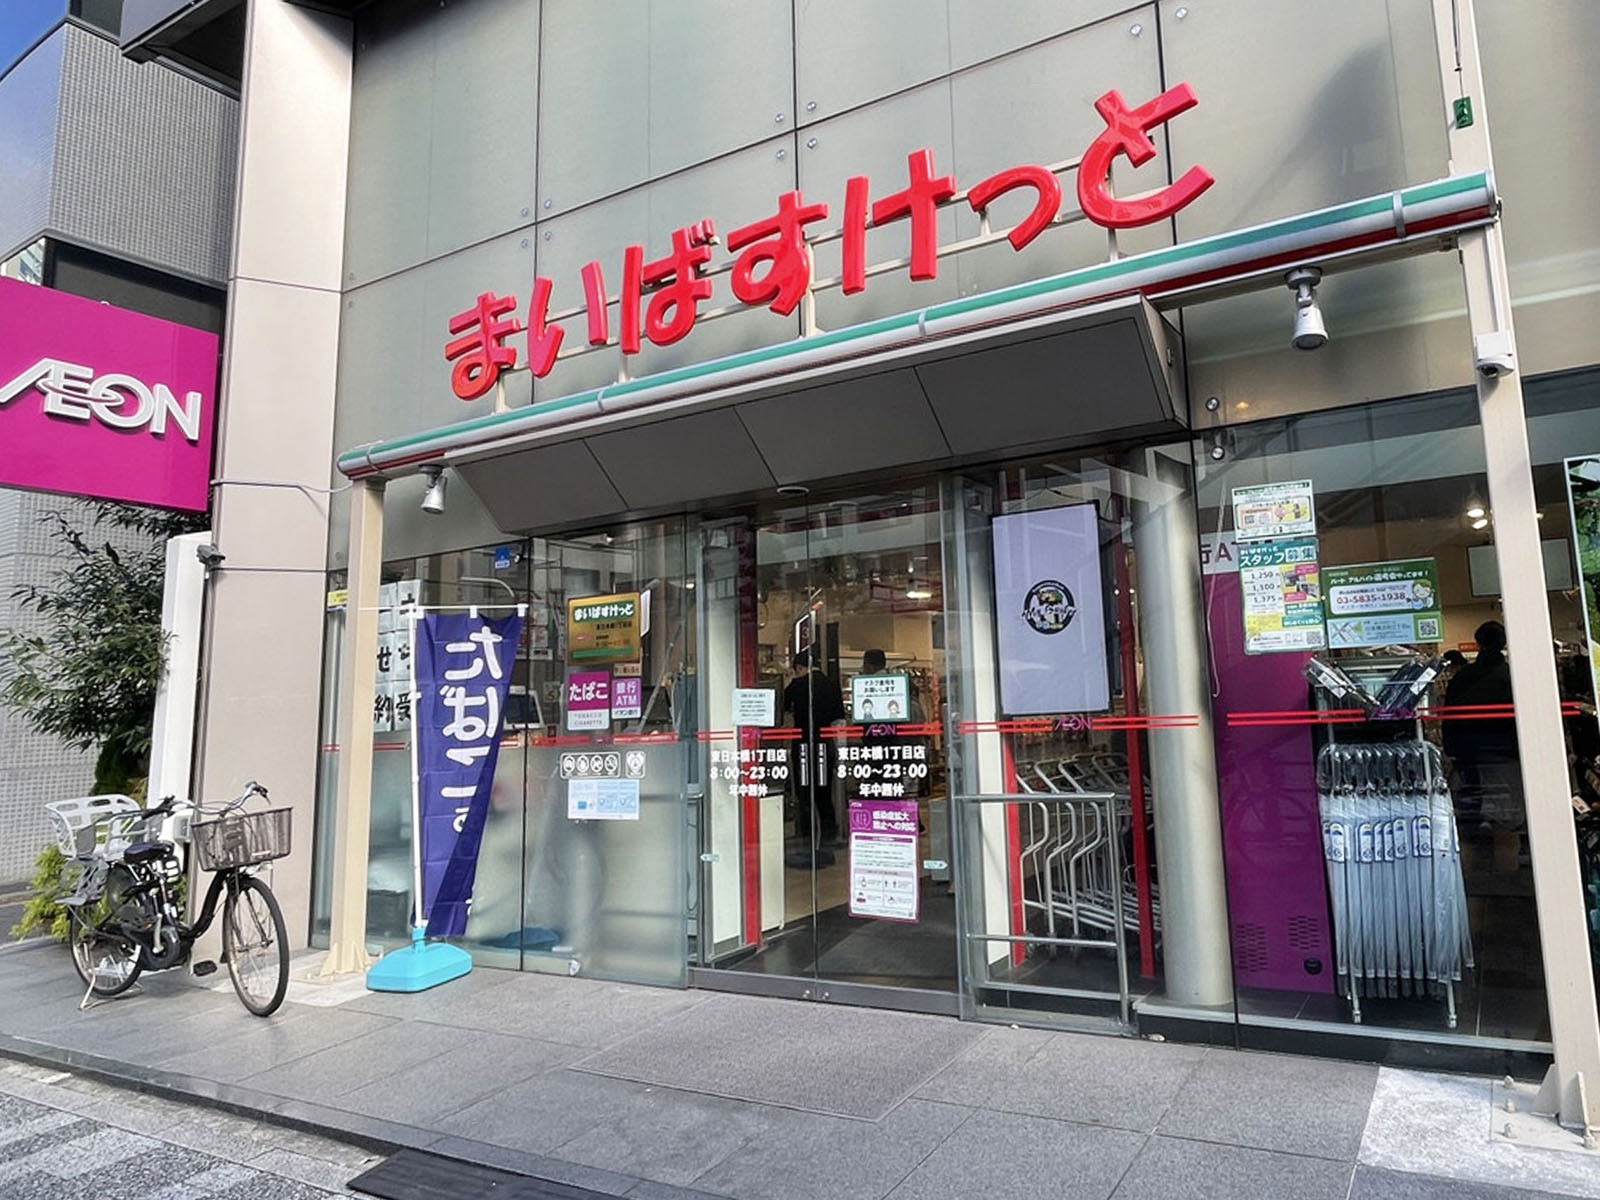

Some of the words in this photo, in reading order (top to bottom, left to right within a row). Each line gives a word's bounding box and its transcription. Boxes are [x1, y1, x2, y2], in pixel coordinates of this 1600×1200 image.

[445, 81, 1215, 400] まいばすけっと
[569, 681, 608, 701] たばこ
[616, 681, 636, 695] 銀行
[615, 695, 637, 706] ATM
[838, 745, 926, 760] 東日本橋1丁目店
[859, 782, 905, 797] 年中無休
